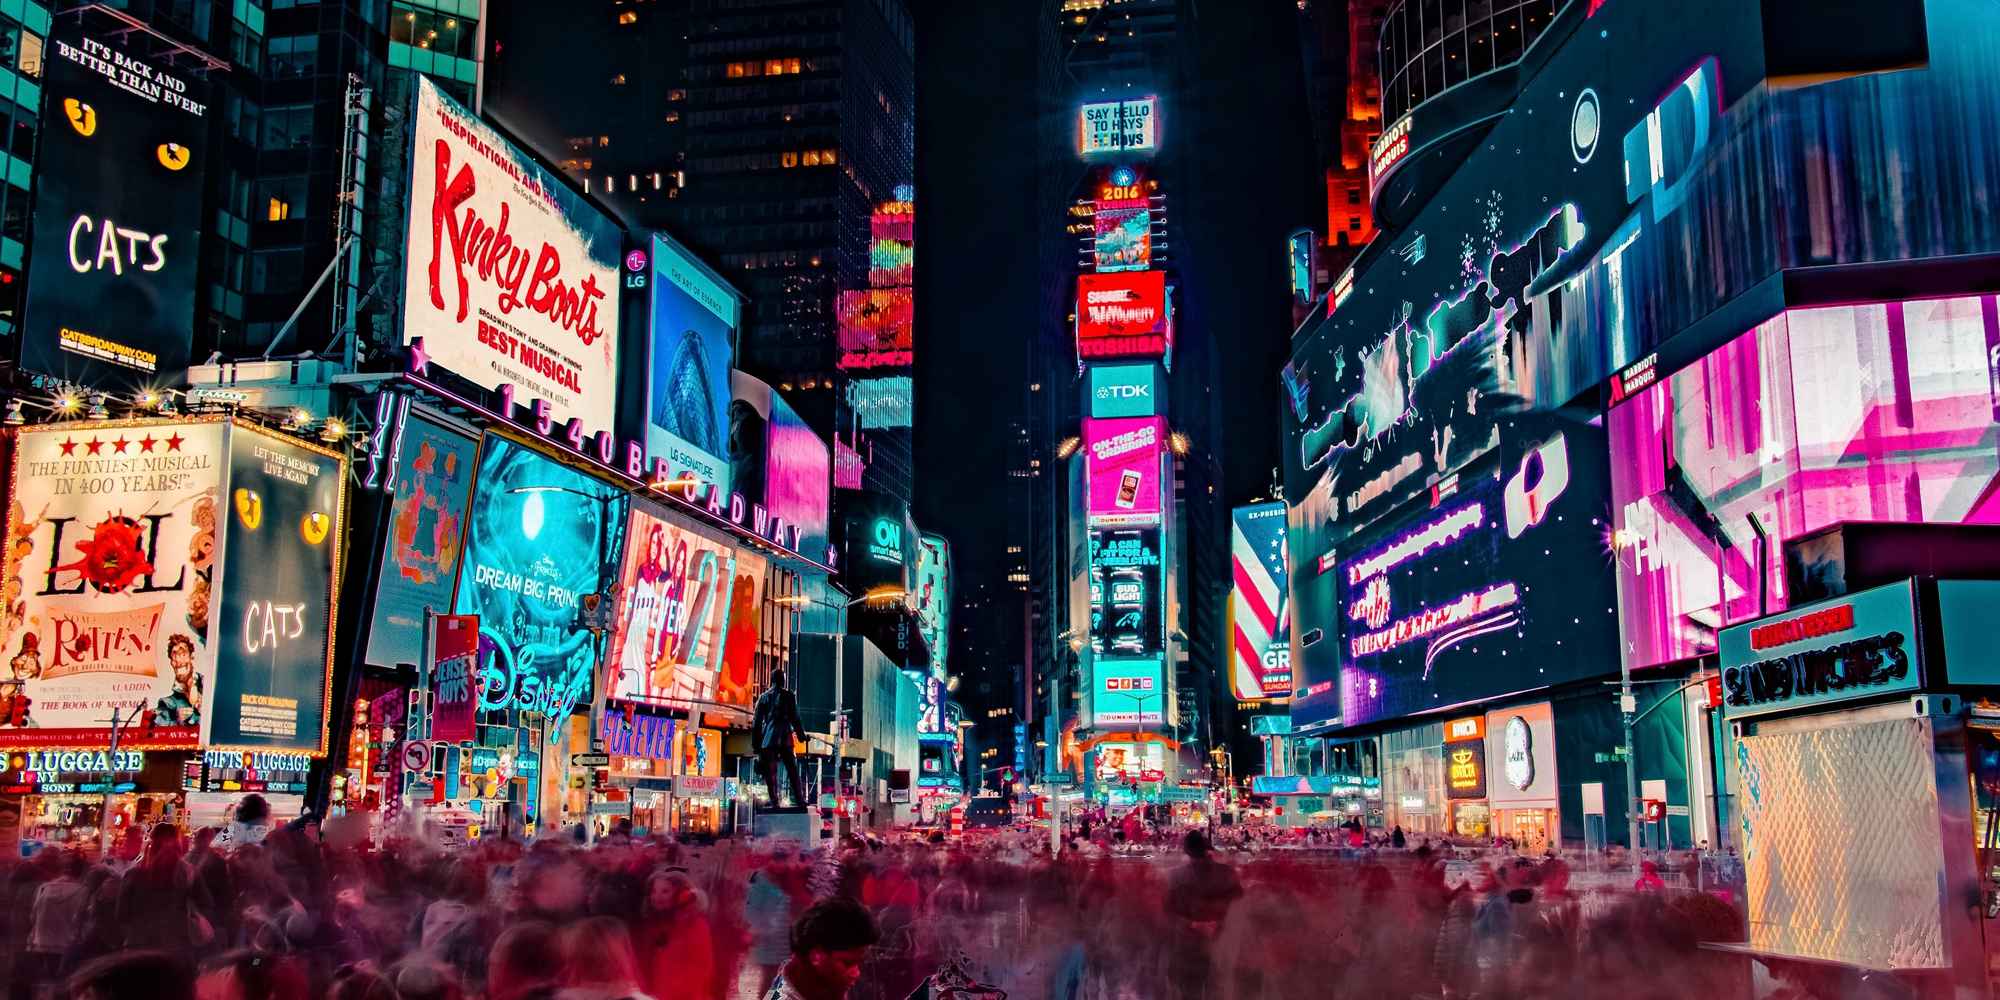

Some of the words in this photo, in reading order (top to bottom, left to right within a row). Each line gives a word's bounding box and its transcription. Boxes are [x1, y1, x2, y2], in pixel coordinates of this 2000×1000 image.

[83, 37, 111, 60] IT'S
[114, 51, 153, 79] BACK
[155, 71, 186, 93] AND
[120, 69, 161, 98] THAN
[1087, 108, 1109, 121] SAY
[1113, 105, 1149, 119] HELLO
[1094, 120, 1108, 132] TO
[1112, 118, 1143, 131] HAYS
[1111, 133, 1144, 147] Hays
[1374, 116, 1412, 162] MARRIOTT
[1375, 139, 1407, 178] MARQUIS
[522, 174, 542, 197] AND
[1103, 186, 1138, 200] 2016
[69, 215, 168, 275] CATS
[429, 139, 530, 323] Kinky
[525, 241, 606, 346] Boots
[627, 275, 646, 288] LG
[60, 328, 157, 364] CATSBROADWAY.COM
[478, 320, 519, 360] BEST
[520, 342, 582, 394] MUSICAL
[1080, 335, 1165, 356] TOSHIBA
[1624, 352, 1657, 381] MARRIOTT
[1109, 384, 1149, 397] TDK
[1624, 368, 1655, 394] MARQUIS
[1092, 426, 1156, 452] ON-THE-GO
[1097, 435, 1156, 460] ORDERING
[30, 461, 60, 477] THE
[62, 458, 140, 476] FUNNIEST
[142, 455, 212, 473] MUSICAL
[254, 445, 269, 460] LET
[270, 449, 286, 466] THE
[287, 456, 320, 477] MEMORY
[264, 461, 283, 478] LIVE
[283, 468, 309, 486] AGAIN
[498, 384, 616, 465] 1540
[627, 439, 802, 552] BROADWAY
[670, 447, 679, 462] LG
[680, 452, 713, 479] SIGNATURE
[54, 478, 76, 495] IN
[79, 477, 115, 494] 400
[876, 520, 900, 550] ON
[1109, 540, 1117, 549] A
[1118, 540, 1141, 549] CAN
[1142, 547, 1150, 557] A
[475, 564, 522, 593] DREAM
[524, 578, 546, 603] BIG,
[1116, 584, 1139, 594] BUD
[1113, 592, 1141, 601] LIGHT
[687, 549, 736, 672] 21
[244, 600, 304, 653] CATS
[1724, 631, 1908, 707] SANDWICHES
[112, 682, 153, 693] ALADDIN
[439, 679, 469, 704] BOYS
[40, 701, 60, 710] THE
[62, 700, 88, 710] BOOK
[91, 700, 102, 709] OF
[603, 710, 676, 761] FOREVER
[27, 751, 145, 772] LUGGAGE
[204, 751, 243, 769] GIFTS
[253, 752, 312, 772] LUGGAGE
[36, 771, 58, 783] NY
[41, 783, 75, 793] SONY
[267, 782, 289, 791] SONY
